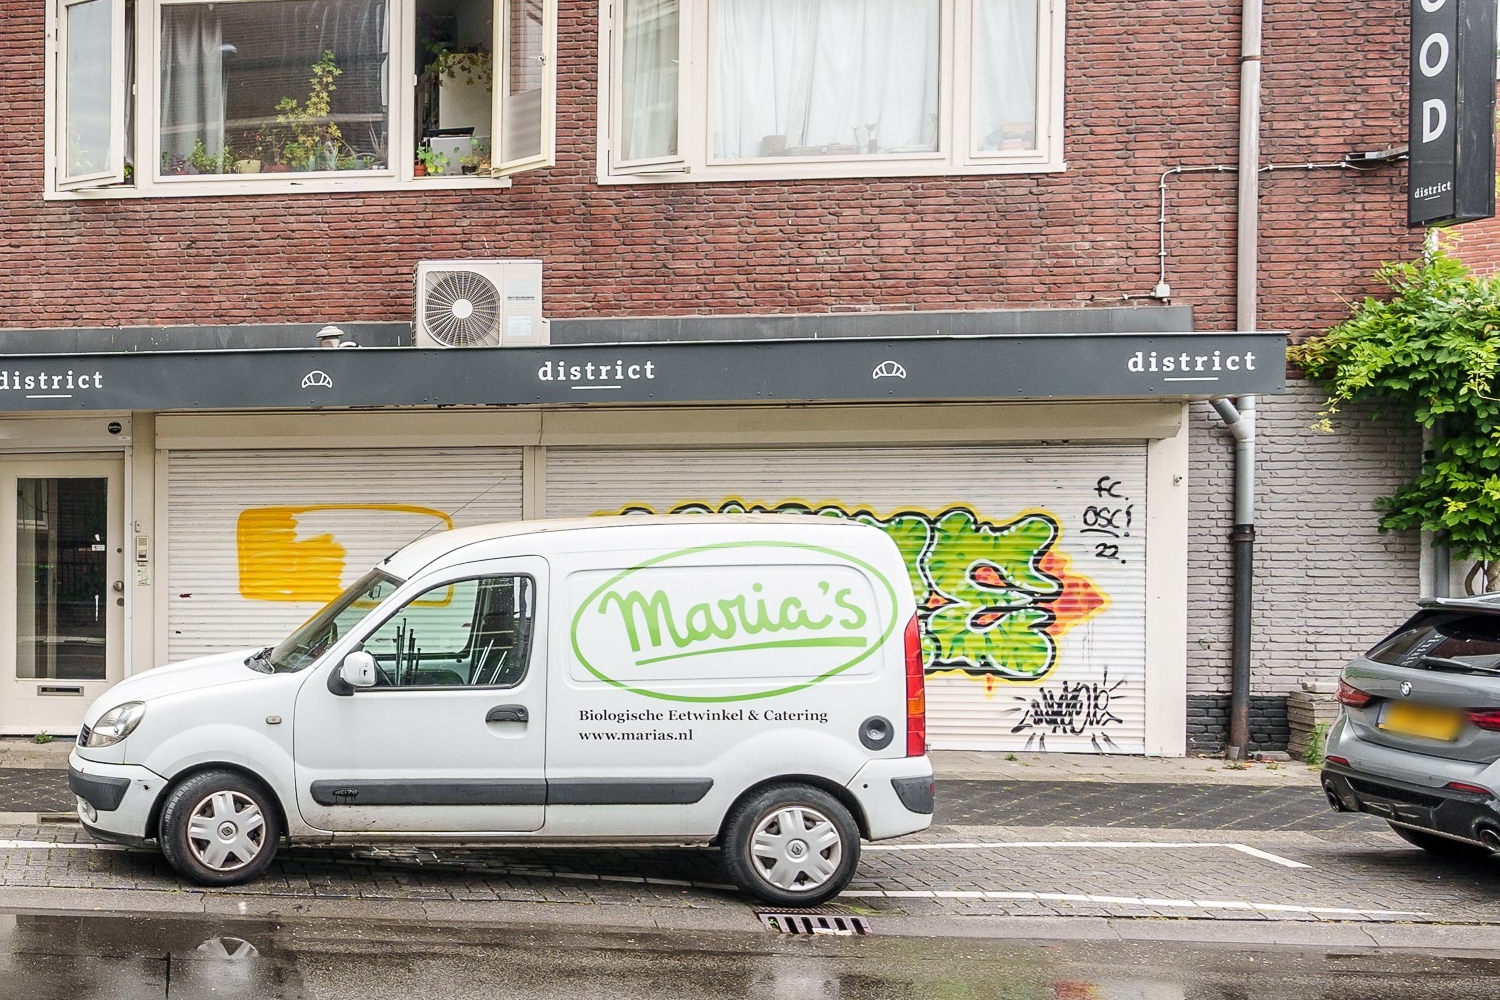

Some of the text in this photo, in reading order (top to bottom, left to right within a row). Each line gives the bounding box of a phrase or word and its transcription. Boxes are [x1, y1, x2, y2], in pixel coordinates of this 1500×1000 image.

[1414, 180, 1452, 199] district
[538, 360, 655, 381] district
[1127, 350, 1256, 372] district
[598, 580, 867, 653] Maria's
[578, 709, 829, 723] Biologische Eetwinkel & Catering
[578, 729, 693, 741] www.marias.nl
